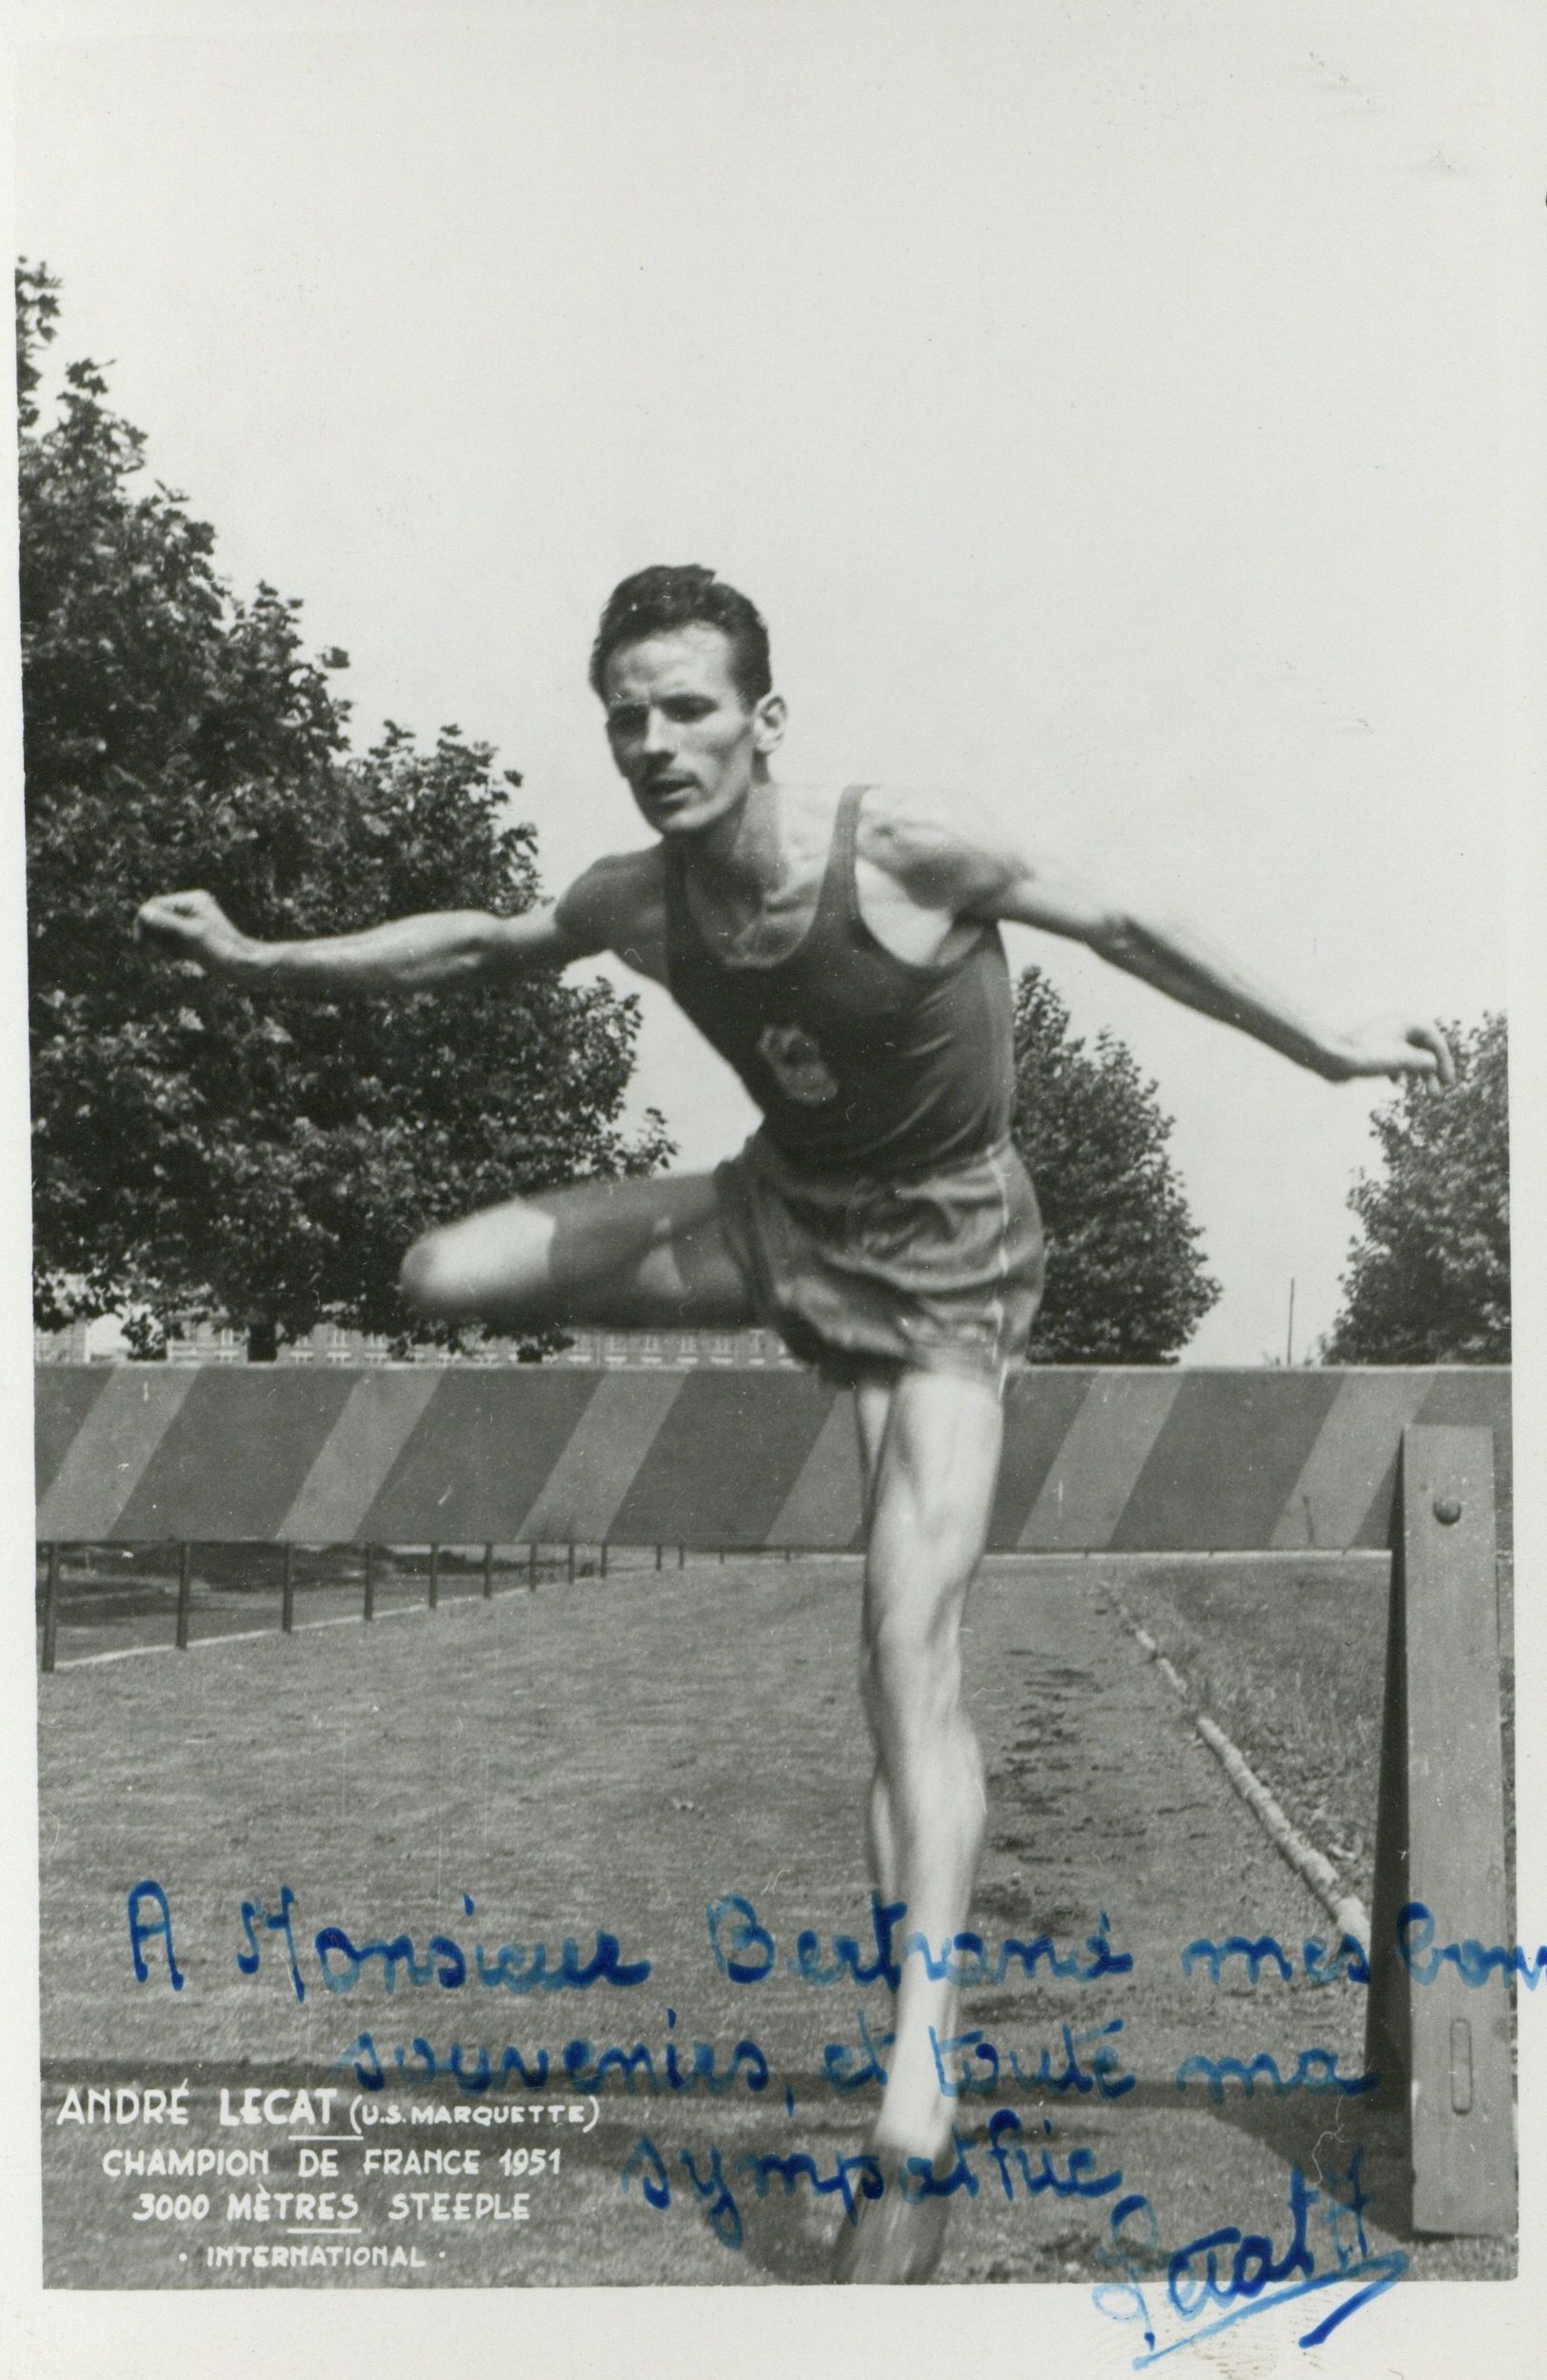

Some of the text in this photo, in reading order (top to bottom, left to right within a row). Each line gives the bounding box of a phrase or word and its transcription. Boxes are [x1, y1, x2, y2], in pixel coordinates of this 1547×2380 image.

[127, 1879, 185, 1992] A
[1181, 1934, 1371, 1984] mes
[822, 2011, 897, 2089] et
[1177, 2048, 1377, 2098] ma
